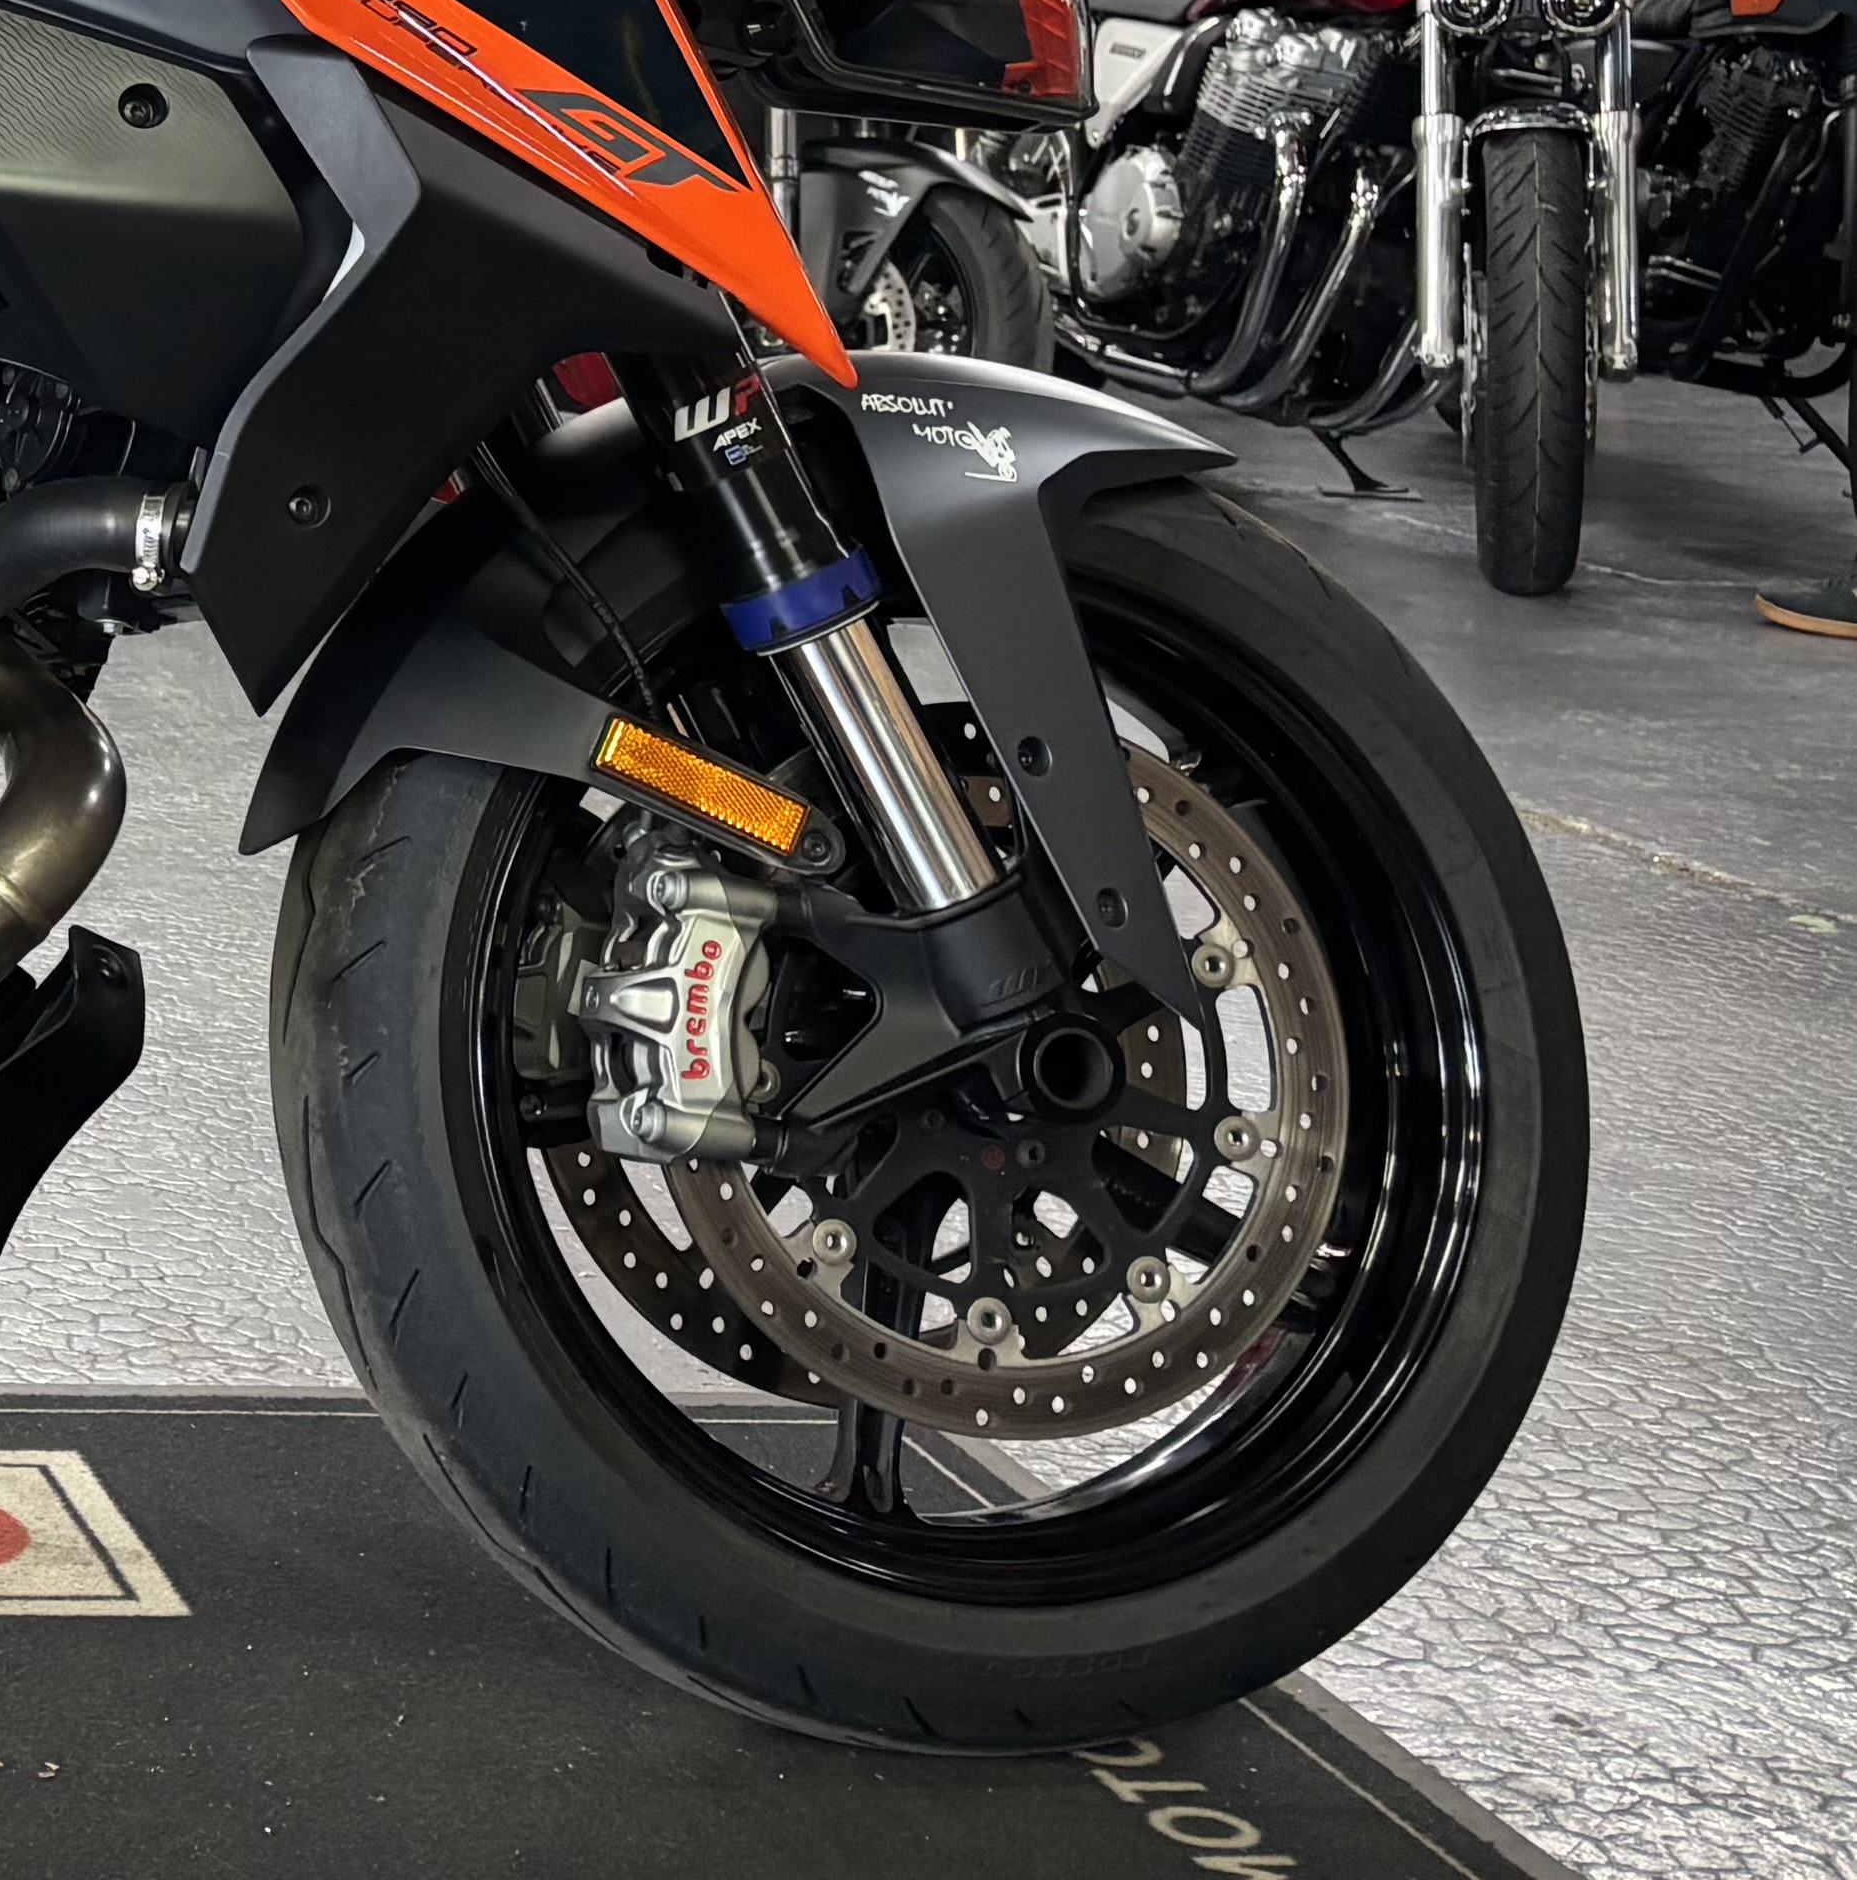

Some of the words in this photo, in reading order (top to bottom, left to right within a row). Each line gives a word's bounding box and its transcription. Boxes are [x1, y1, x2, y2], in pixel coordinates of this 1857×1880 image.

[519, 89, 738, 193] GT
[674, 372, 760, 442] WP
[713, 417, 762, 452] APEX
[681, 939, 723, 1081] brembo
